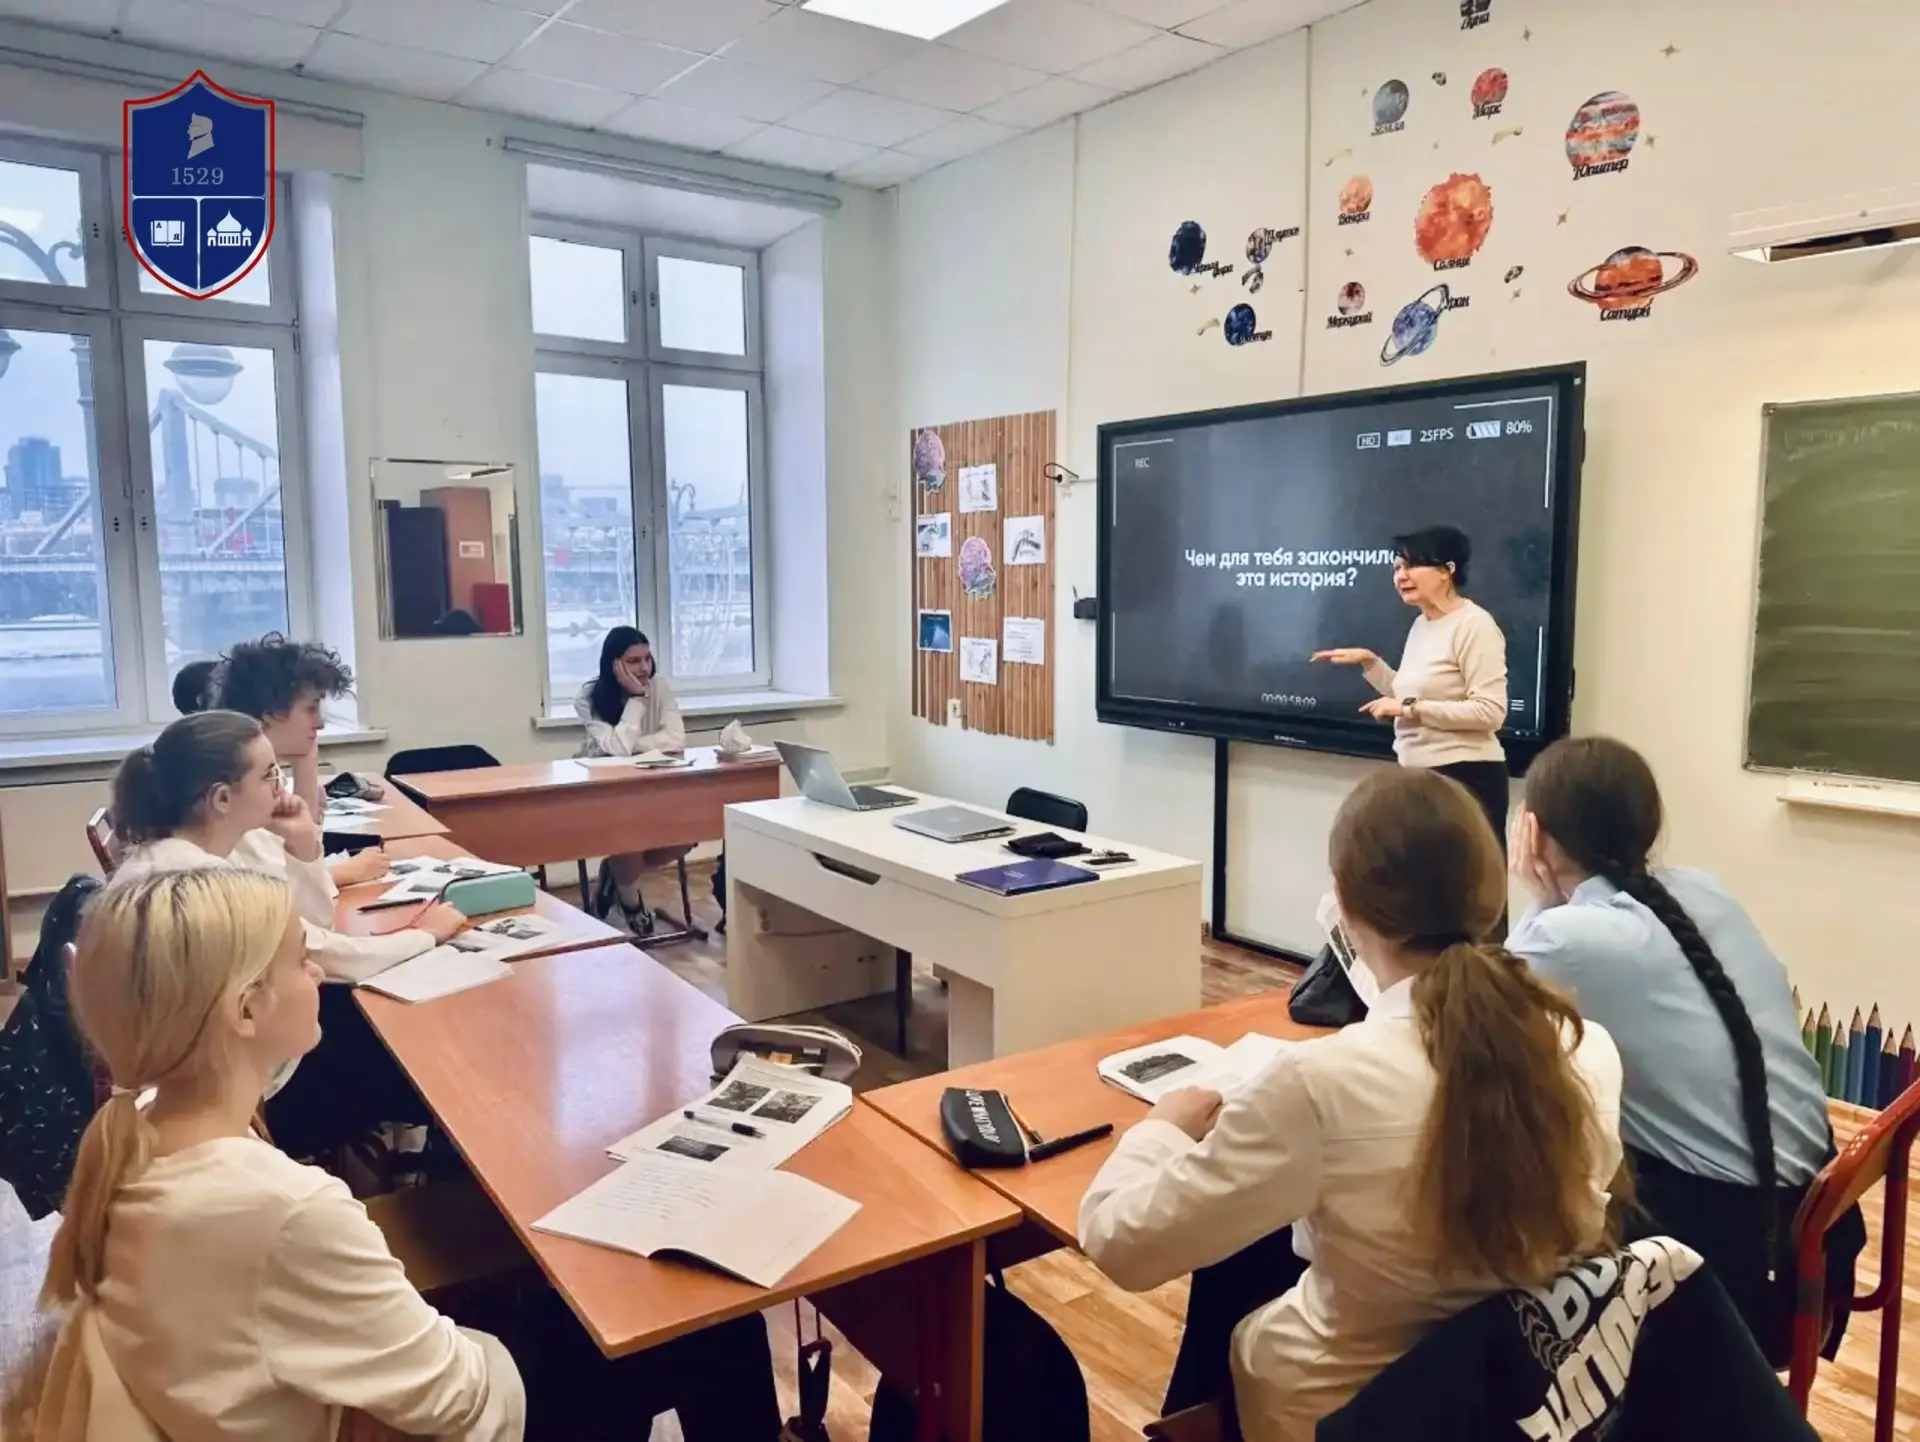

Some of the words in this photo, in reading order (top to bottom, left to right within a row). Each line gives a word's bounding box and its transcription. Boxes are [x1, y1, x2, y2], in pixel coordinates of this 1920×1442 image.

[1573, 158, 1630, 181] Юпитер
[1419, 427, 1454, 443] 25FPS
[1505, 420, 1533, 435] 80%
[1135, 457, 1150, 468] REC
[1185, 549, 1215, 567] Чем
[1219, 551, 1249, 569] для
[1254, 547, 1292, 566] тебя
[1236, 572, 1265, 587] эта
[1270, 567, 1358, 591] история?
